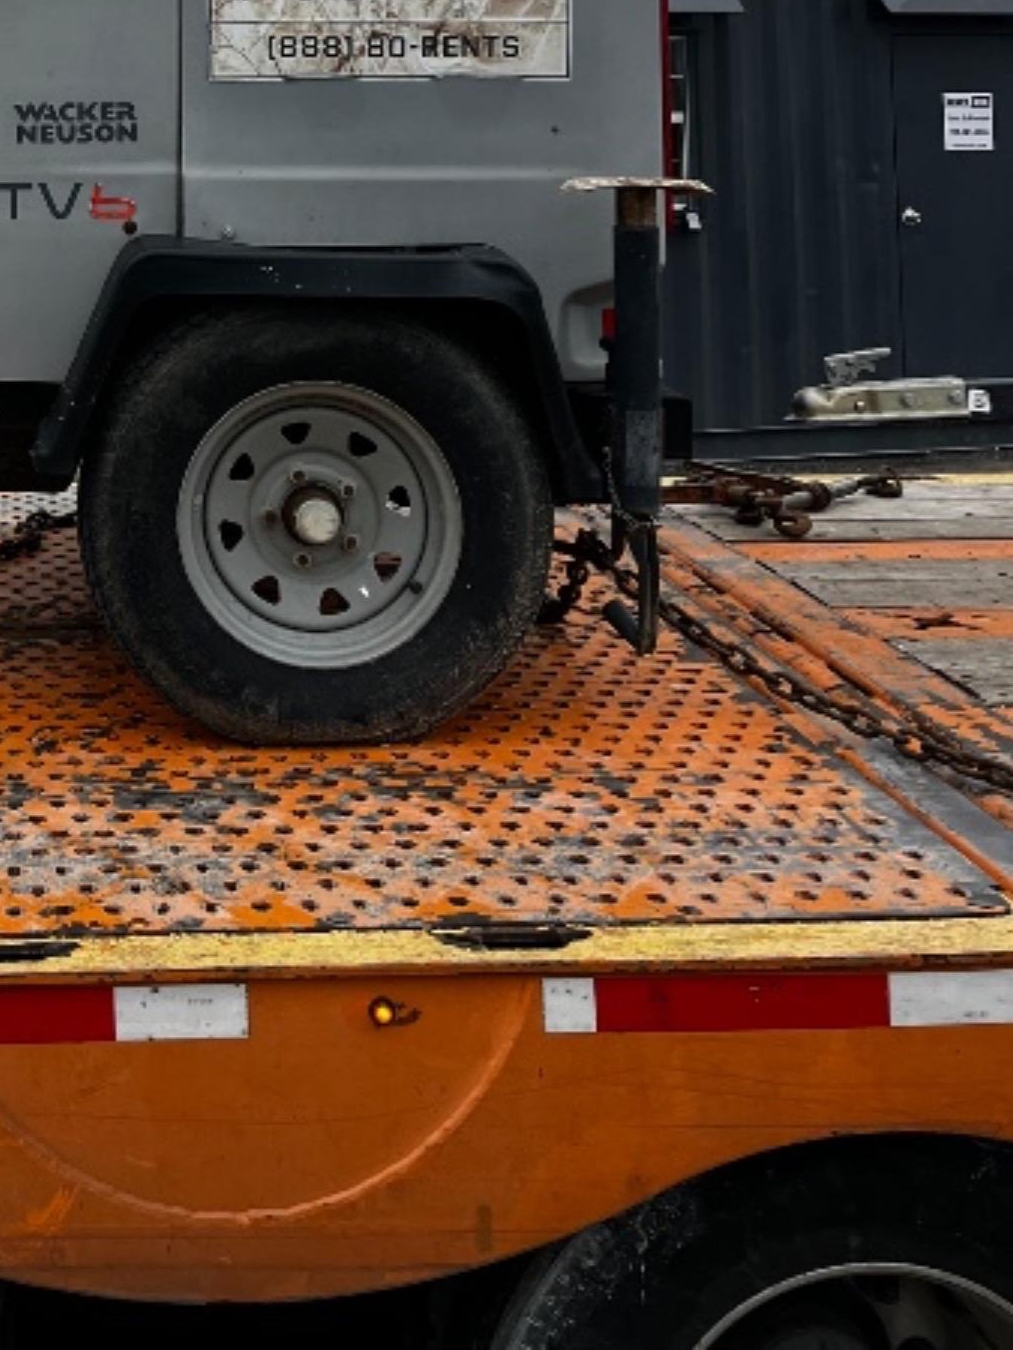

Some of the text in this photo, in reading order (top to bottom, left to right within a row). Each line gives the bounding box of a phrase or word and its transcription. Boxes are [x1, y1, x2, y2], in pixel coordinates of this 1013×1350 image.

[367, 34, 520, 59] 80-RENTS
[14, 101, 138, 122] WACKER
[16, 123, 138, 145] NEUSON
